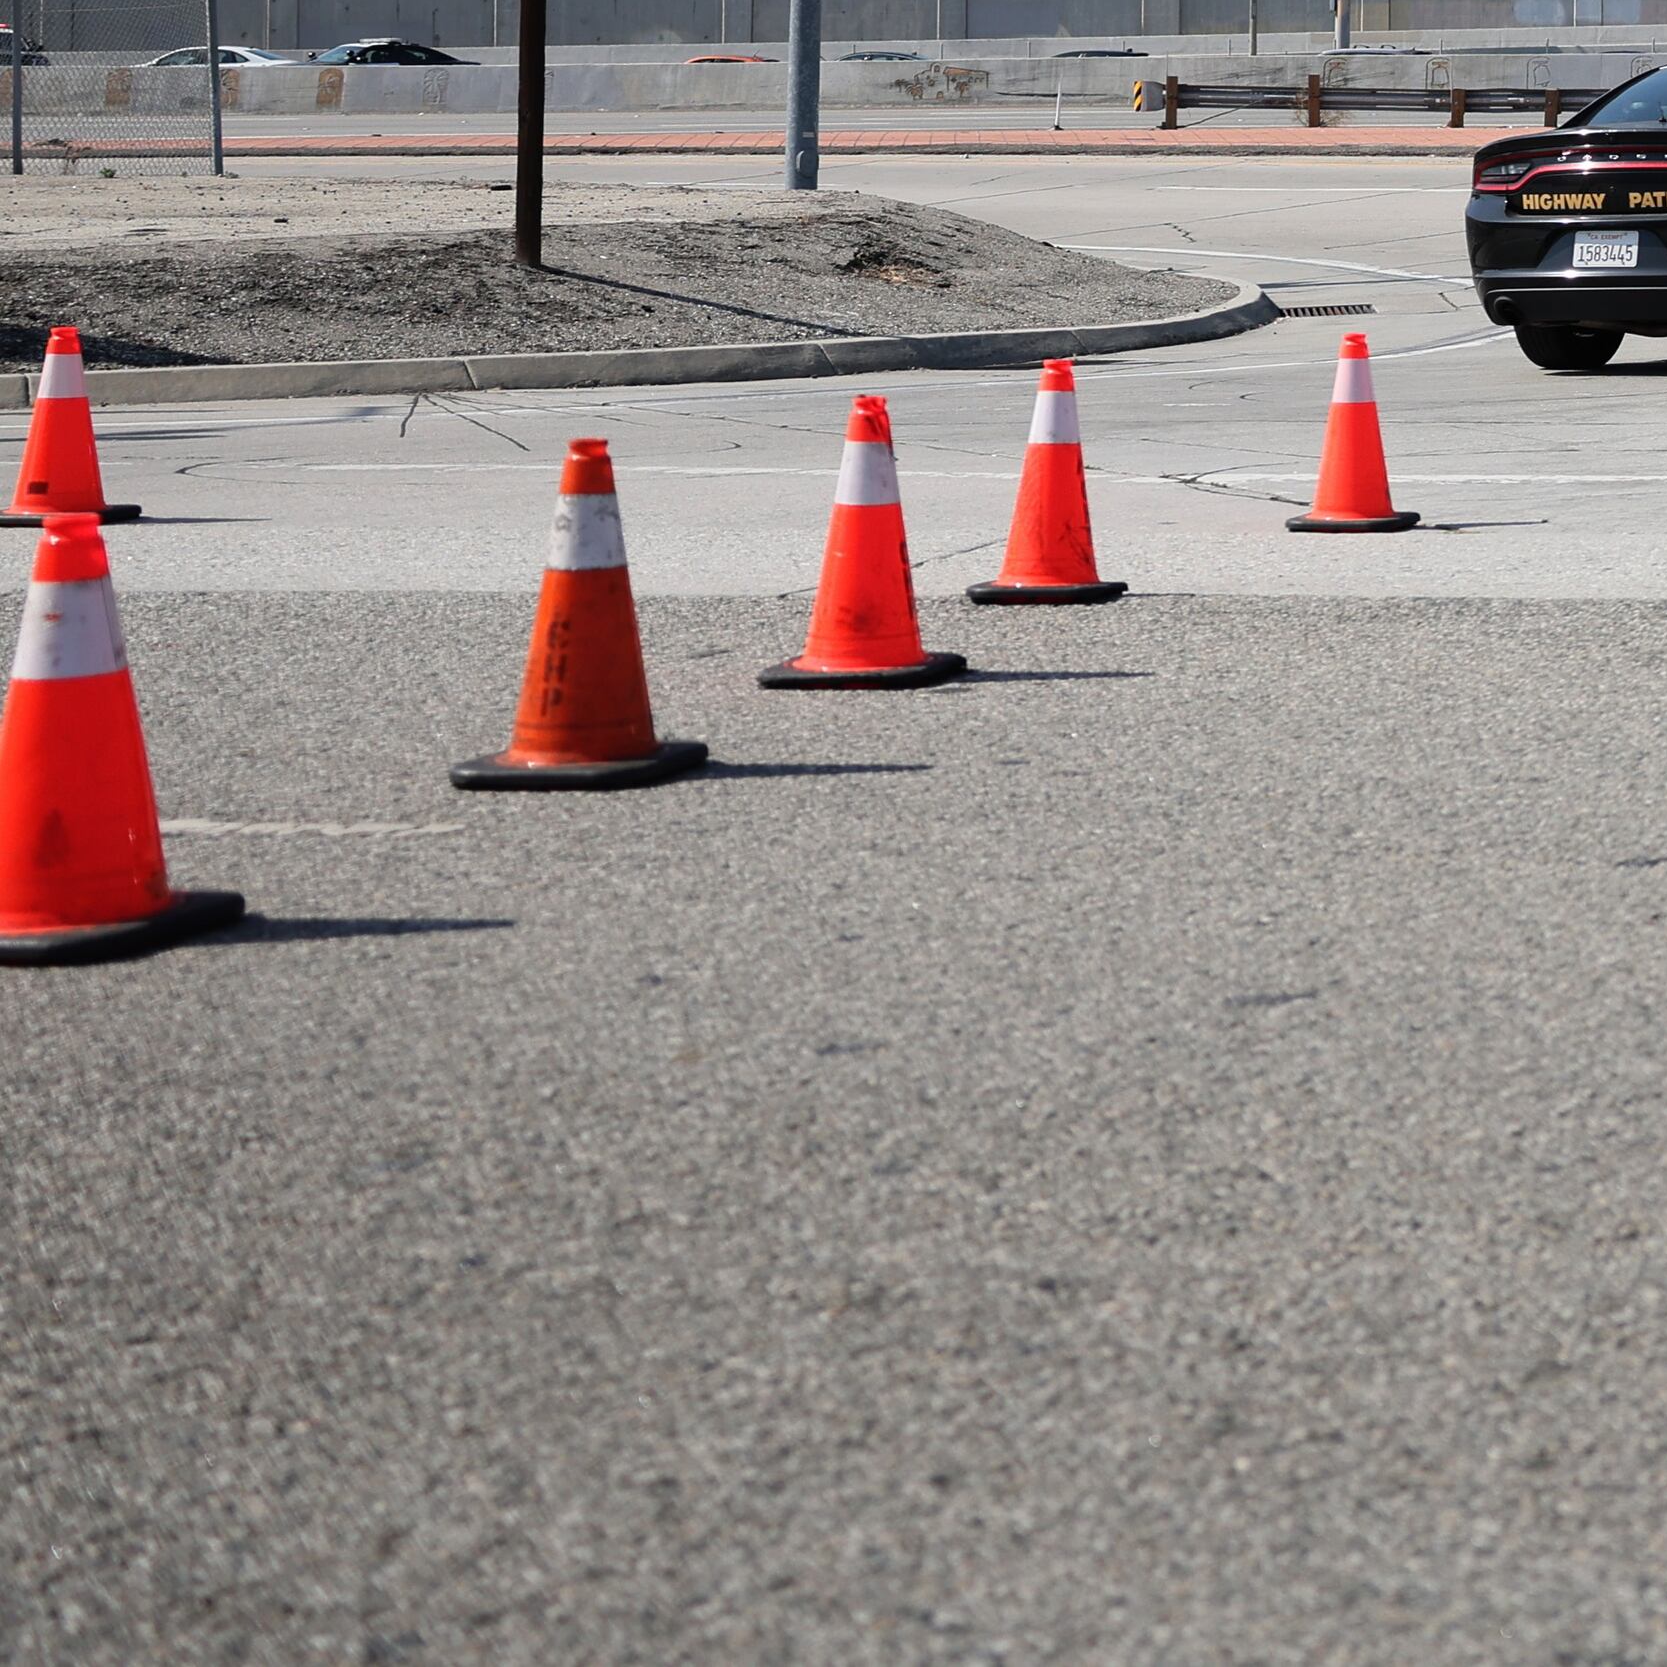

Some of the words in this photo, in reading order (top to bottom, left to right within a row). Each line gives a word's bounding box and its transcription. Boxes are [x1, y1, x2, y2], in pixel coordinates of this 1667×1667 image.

[1522, 192, 1606, 210] HIGHWAY
[1578, 244, 1633, 262] 1583445
[541, 619, 570, 717] CHP
